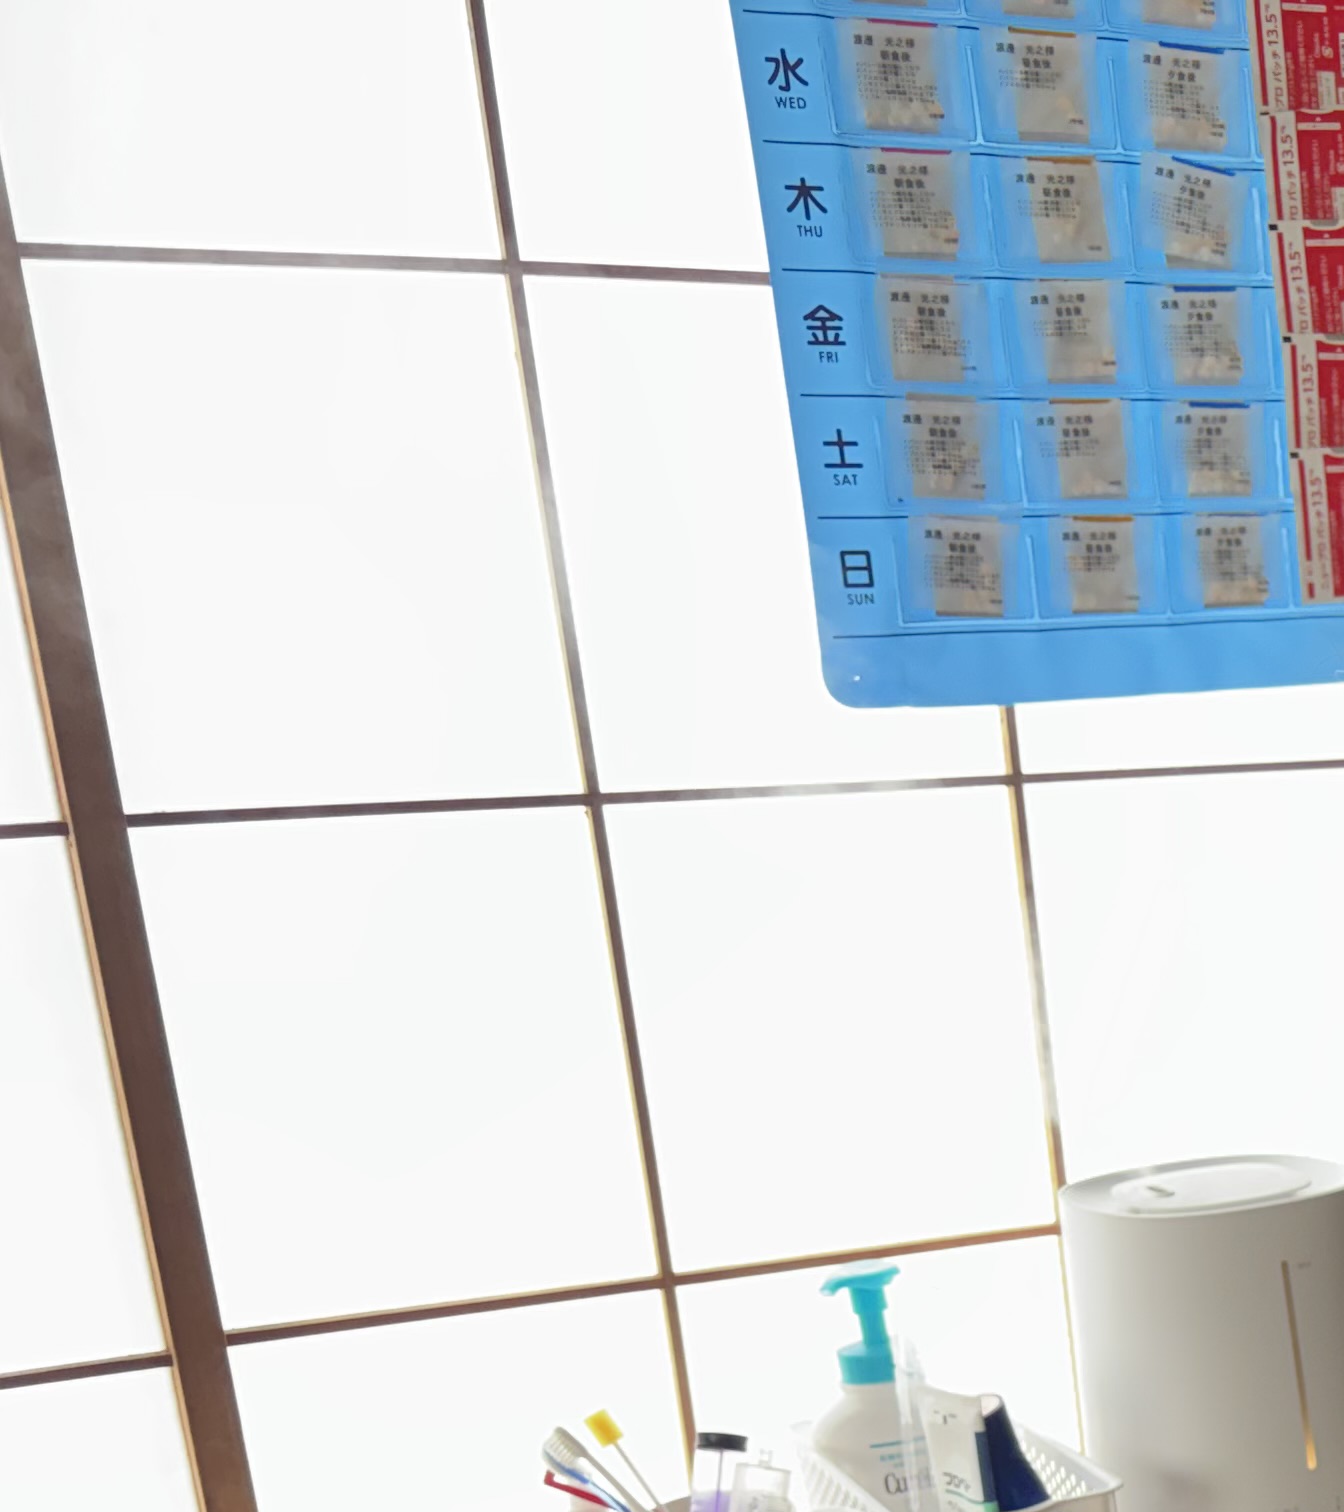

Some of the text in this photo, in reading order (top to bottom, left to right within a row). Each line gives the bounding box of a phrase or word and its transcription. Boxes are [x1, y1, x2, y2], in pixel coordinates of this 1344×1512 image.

[765, 48, 808, 92] 水
[775, 97, 806, 109] WED
[785, 177, 827, 220] 木
[797, 225, 822, 237] THU
[803, 305, 846, 345] 金
[819, 351, 838, 363] FRI
[823, 429, 863, 468] 土
[833, 474, 857, 486] SAT
[840, 550, 874, 588] 日
[847, 593, 875, 606] SUN
